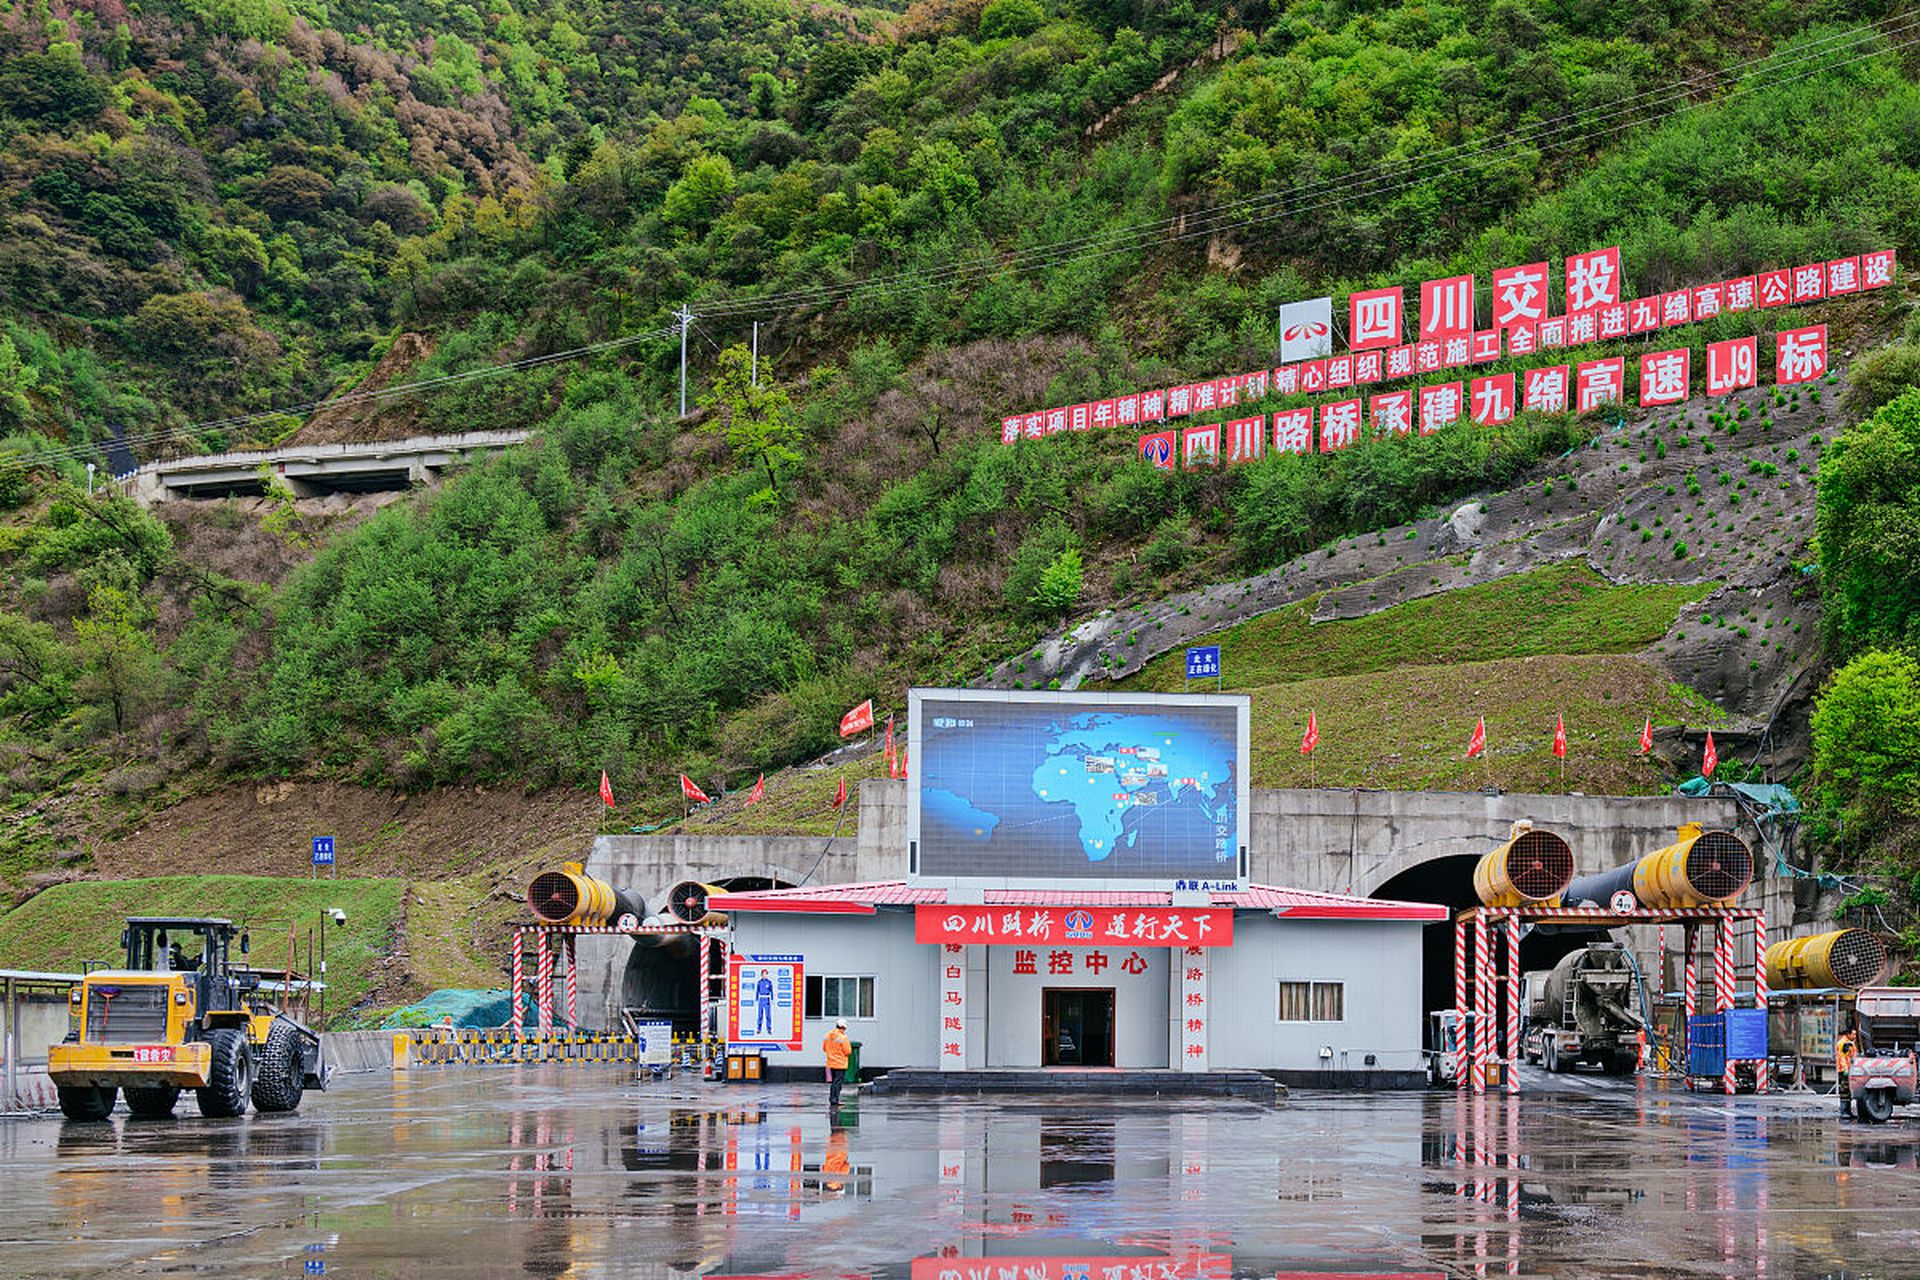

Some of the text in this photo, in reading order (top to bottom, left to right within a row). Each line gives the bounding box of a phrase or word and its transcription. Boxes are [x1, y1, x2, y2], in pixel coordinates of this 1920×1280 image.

[1356, 255, 1615, 343] 四川交投
[1201, 881, 1238, 891] A-Link
[942, 910, 1213, 941] 四川路桥 道行天下
[1013, 950, 1149, 975] 监控中心
